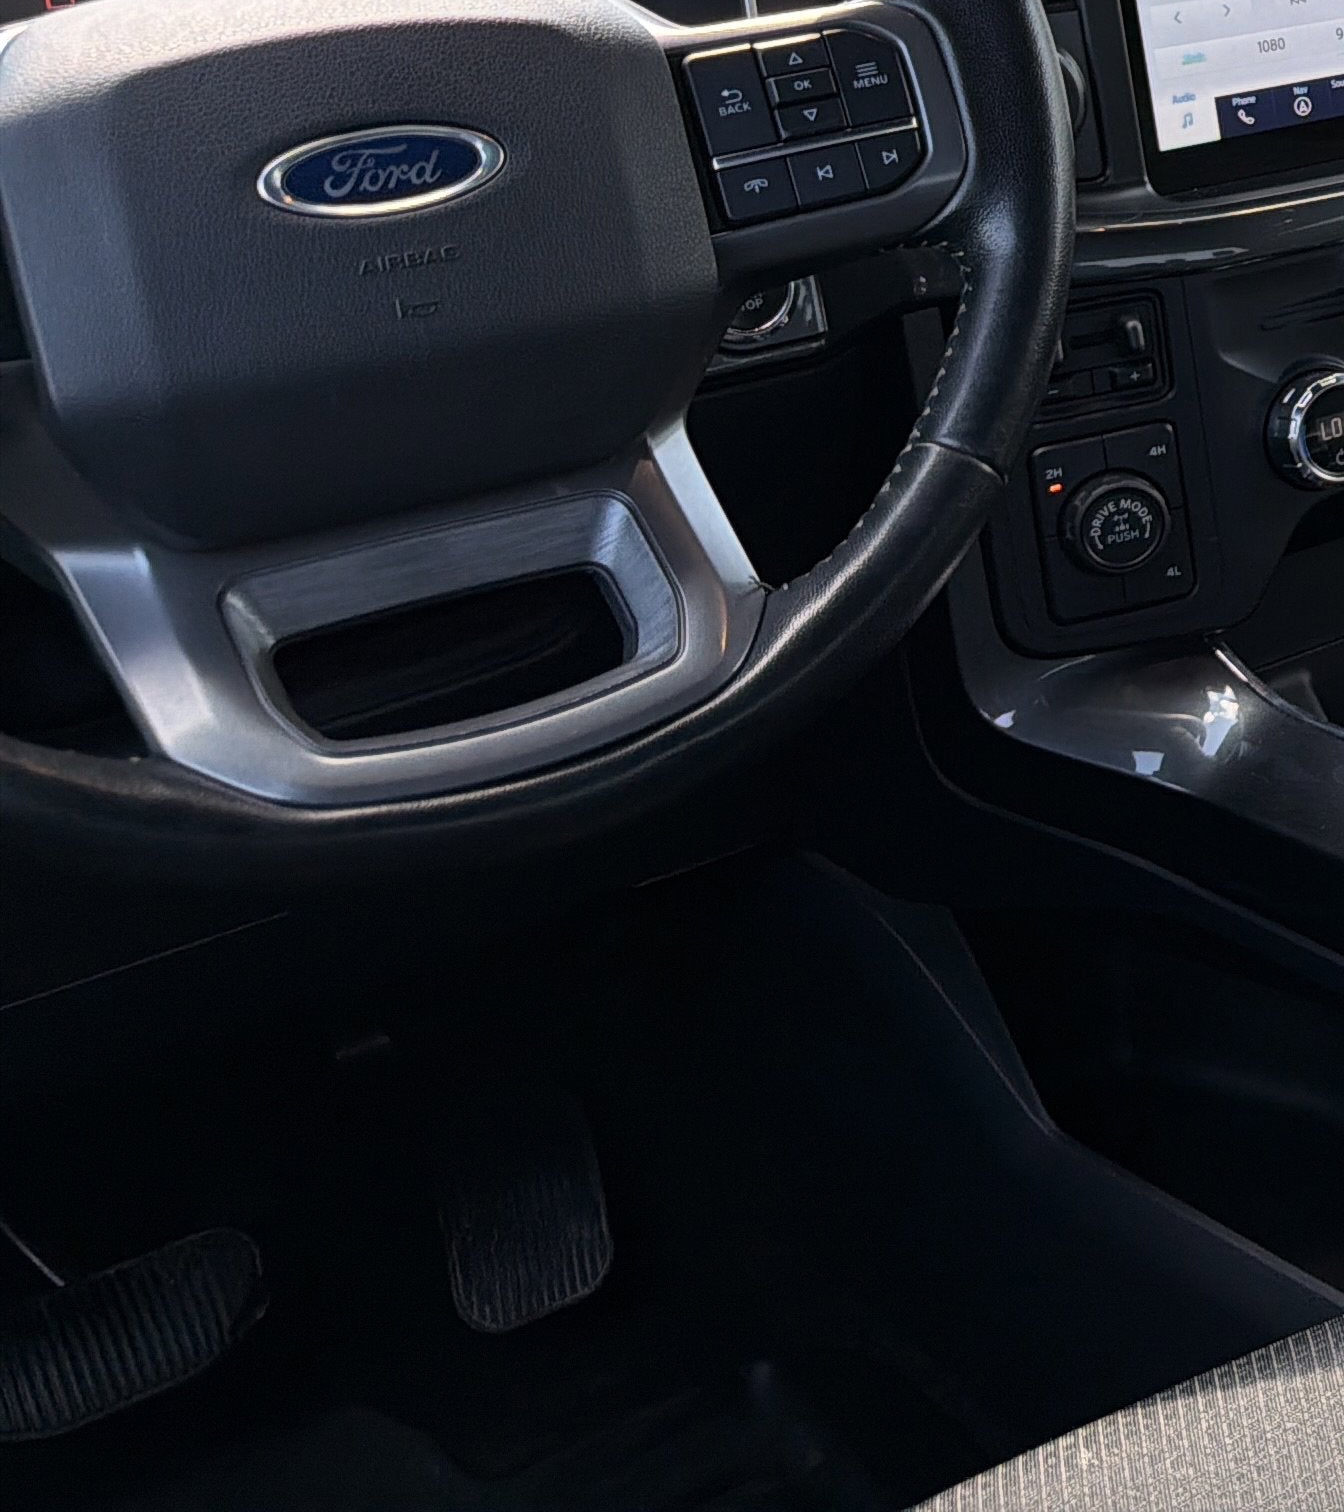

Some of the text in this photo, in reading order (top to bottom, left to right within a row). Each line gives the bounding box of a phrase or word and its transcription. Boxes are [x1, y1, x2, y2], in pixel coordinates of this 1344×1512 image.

[1257, 37, 1286, 53] 1080
[794, 79, 812, 91] OK
[853, 74, 888, 89] MENU
[1172, 93, 1196, 104] Audio
[1232, 95, 1256, 106] Phone
[718, 102, 751, 117] BACK
[323, 143, 442, 198] Ford
[741, 298, 763, 311] OP
[1320, 416, 1342, 441] LO
[1149, 444, 1166, 456] 4H
[1045, 467, 1062, 479] 2H
[1090, 498, 1152, 537] DRIVE MODE
[1107, 528, 1140, 544] PUSH
[1167, 566, 1181, 577] 4L
